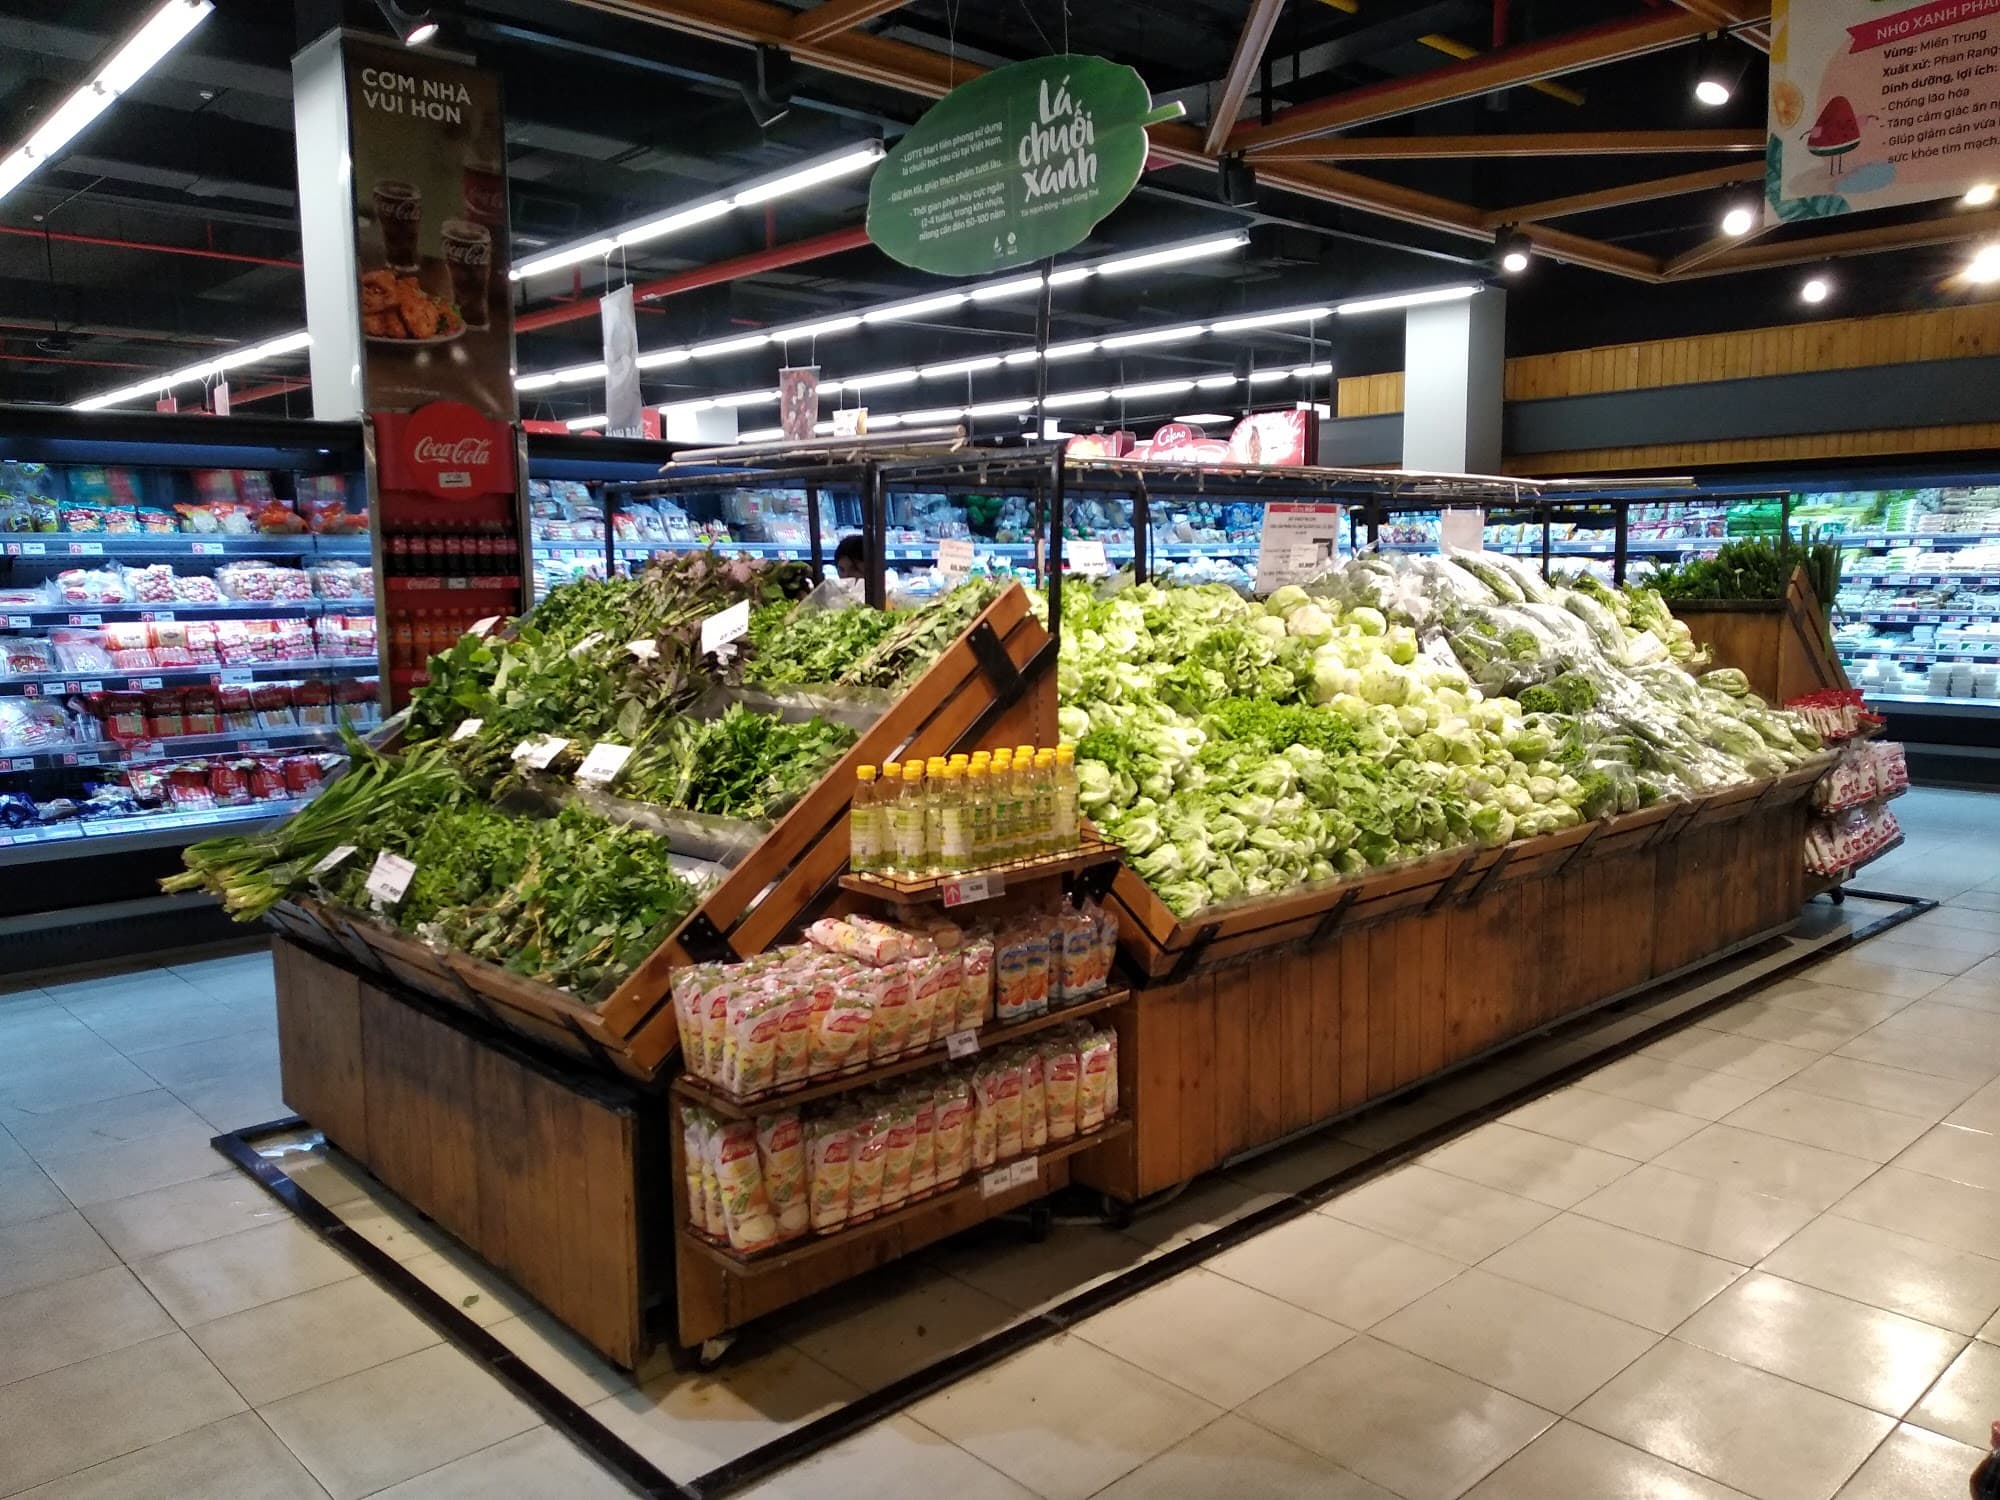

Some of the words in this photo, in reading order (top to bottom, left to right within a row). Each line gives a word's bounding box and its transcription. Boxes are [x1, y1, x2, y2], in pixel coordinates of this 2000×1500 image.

[1876, 20, 1910, 40] NHO
[1913, 6, 1957, 30] XANH
[1883, 45, 1917, 59] Vùng:
[1920, 36, 1949, 52] Miền
[1952, 29, 1987, 44] Trung
[1882, 63, 1910, 78] Xuất
[1912, 59, 1931, 72] xứ:
[1934, 52, 1964, 66] Phan
[1882, 82, 1909, 95] Dinh
[1911, 73, 1954, 89] dưỡng,
[1957, 69, 1972, 80] lợi
[1975, 64, 1998, 76] ích:
[362, 68, 415, 94] CƠM
[423, 81, 472, 106] NHÀ
[1040, 75, 1072, 125] Lá
[1888, 97, 1925, 111] Chống
[1928, 93, 1945, 103] lão
[1948, 88, 1970, 100] hóa
[362, 89, 403, 114] VUI
[412, 99, 461, 124] HƠN
[1888, 116, 1914, 128] Tăng
[1917, 111, 1942, 124] cảm
[1944, 106, 1969, 120] giác
[1972, 102, 1987, 113] ăn
[904, 148, 922, 163] LOTTE
[923, 143, 939, 156] Mart
[952, 131, 974, 147] phong
[1019, 100, 1094, 167] chuối
[1889, 133, 1915, 147] Giúp
[1917, 128, 1946, 143] giảm
[1948, 123, 1970, 135] cân
[1973, 118, 1996, 131] vừa
[1888, 152, 1908, 164] sức
[1911, 147, 1939, 160] khỏe
[1942, 143, 1961, 155] tim
[1022, 147, 1097, 203] xanh
